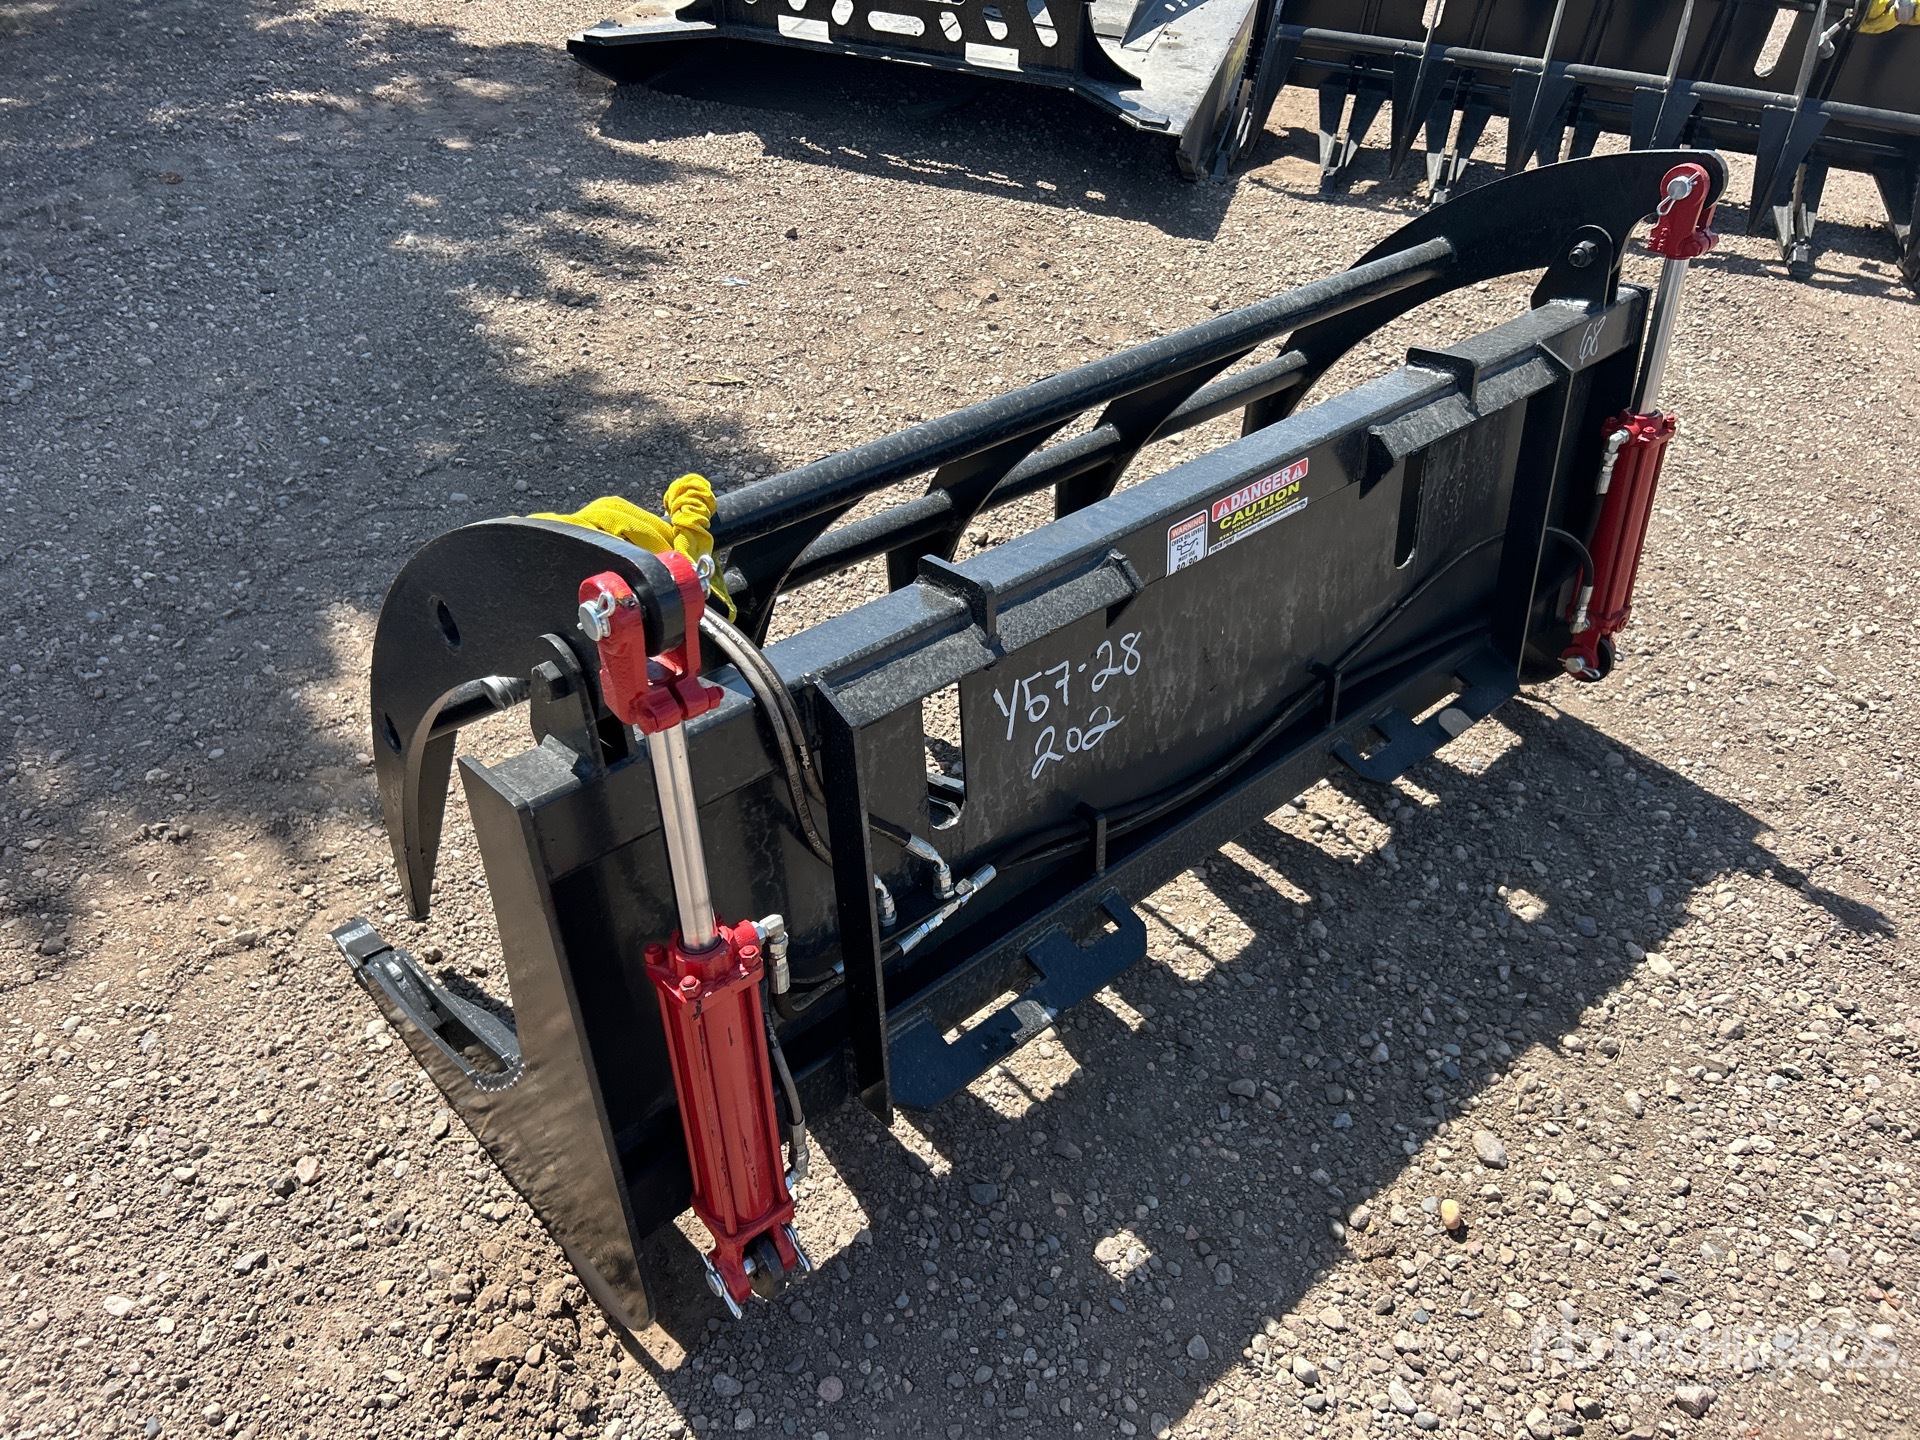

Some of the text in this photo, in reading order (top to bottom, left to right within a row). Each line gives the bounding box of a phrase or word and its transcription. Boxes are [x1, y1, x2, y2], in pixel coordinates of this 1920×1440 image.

[1578, 315, 1607, 366] 68
[1219, 480, 1300, 531] CAUTION
[1231, 468, 1292, 512] DANGER
[1171, 515, 1205, 540] WARNING
[1171, 534, 1184, 547] CHECK
[1191, 525, 1205, 539] LEVELS
[1233, 522, 1253, 535] CLEAR
[1261, 509, 1275, 522] THIS
[1274, 496, 1300, 516] MACHINE
[1030, 705, 1126, 780] 202
